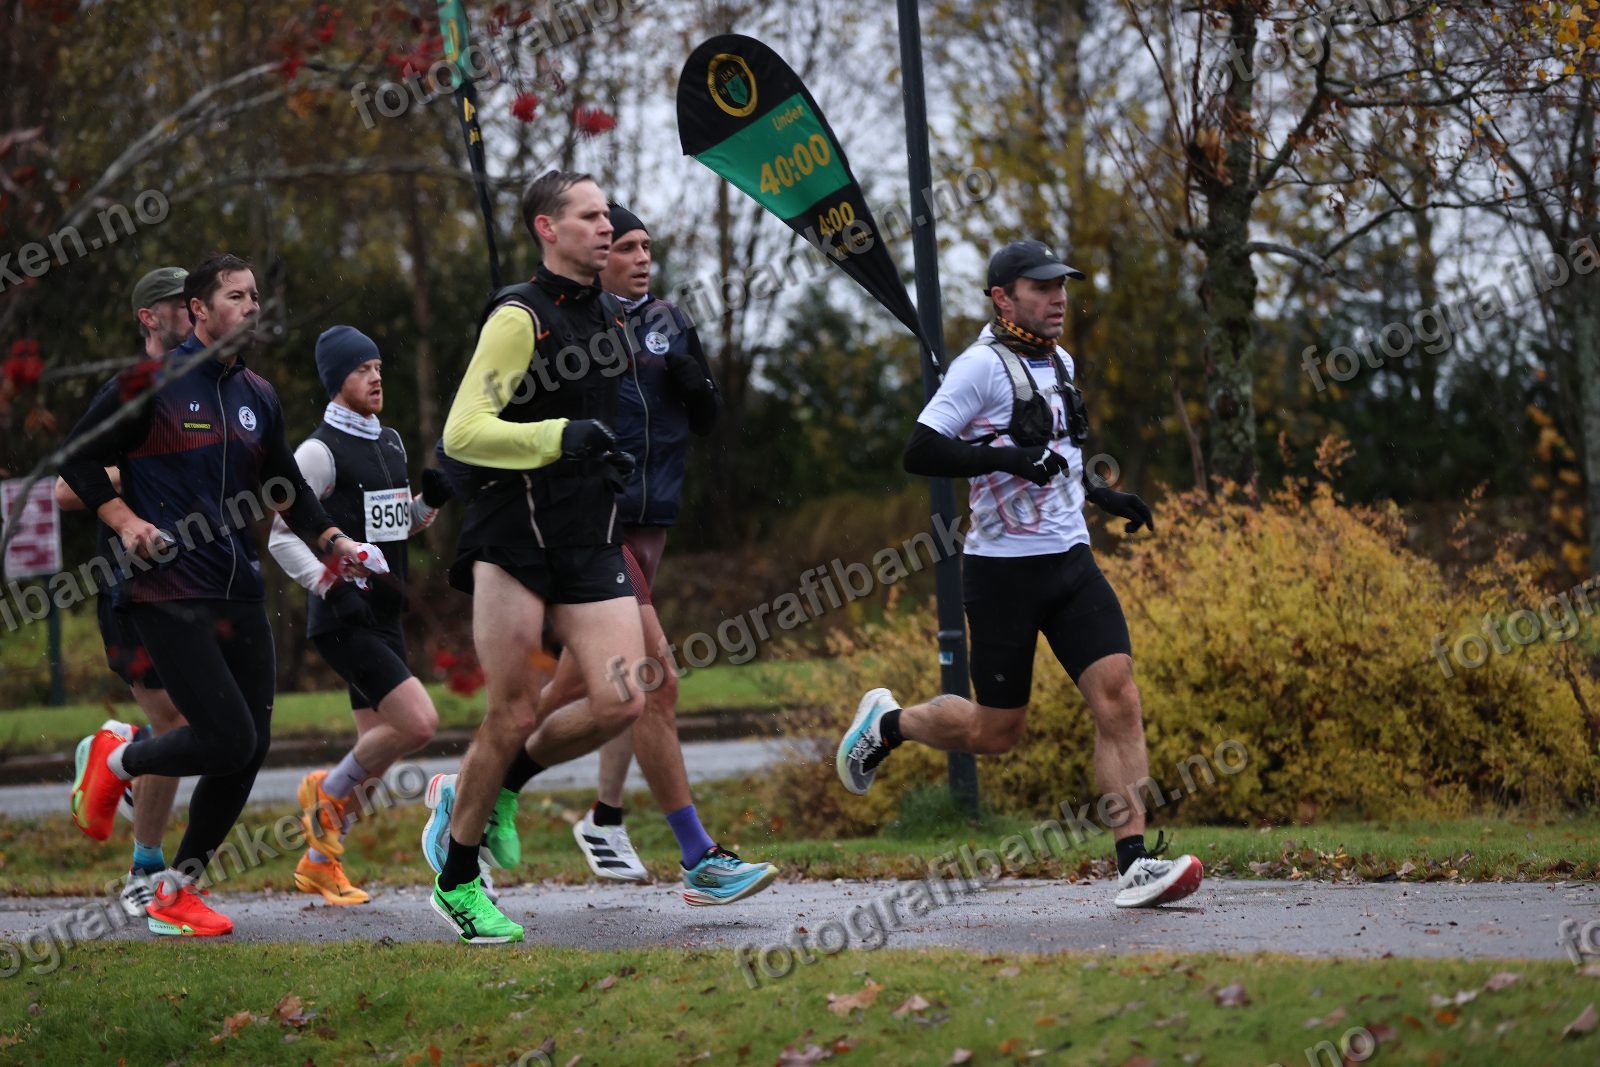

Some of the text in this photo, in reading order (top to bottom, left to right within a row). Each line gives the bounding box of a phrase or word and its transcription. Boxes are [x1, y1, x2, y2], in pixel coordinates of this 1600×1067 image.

[772, 104, 804, 131] Under
[759, 133, 831, 195] 40:00
[819, 201, 856, 236] 4:00
[371, 501, 409, 529] 9509
